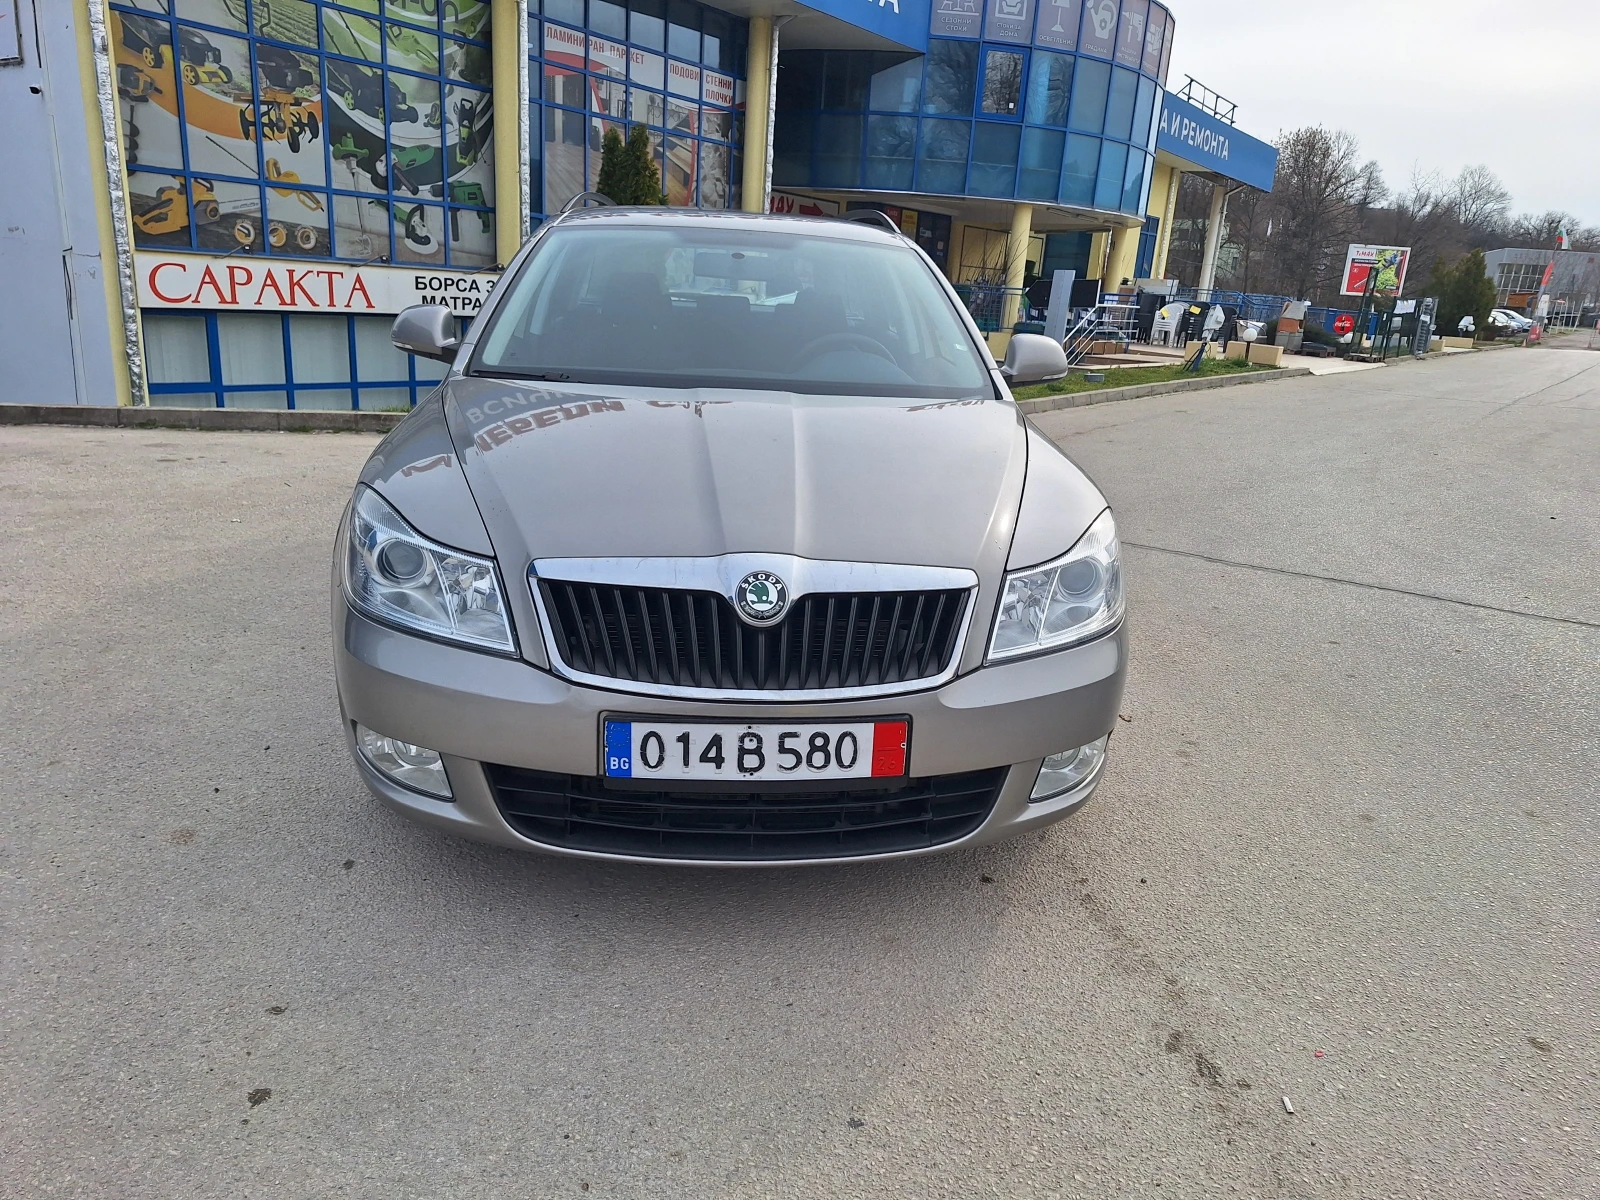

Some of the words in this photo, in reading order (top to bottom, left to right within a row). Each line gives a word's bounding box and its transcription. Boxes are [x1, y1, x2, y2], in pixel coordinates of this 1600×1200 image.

[941, 16, 972, 25] СЕЗОННИ
[945, 24, 968, 32] СТОКИ
[546, 26, 605, 53] ЛАМИНИРАН
[610, 45, 645, 65] ПАРКЕТ
[1038, 34, 1074, 46] ОСВЕТЛЕНИЕ
[669, 63, 700, 81] ПОДОВИ
[705, 74, 733, 91] СТЕННИ
[705, 88, 734, 105] ПЛОЧКИ
[1170, 111, 1181, 138] И
[1181, 117, 1229, 161] РЕМОНТА
[148, 262, 376, 309] САРАКТА
[414, 275, 481, 294] БОРСА
[610, 756, 630, 770] BG
